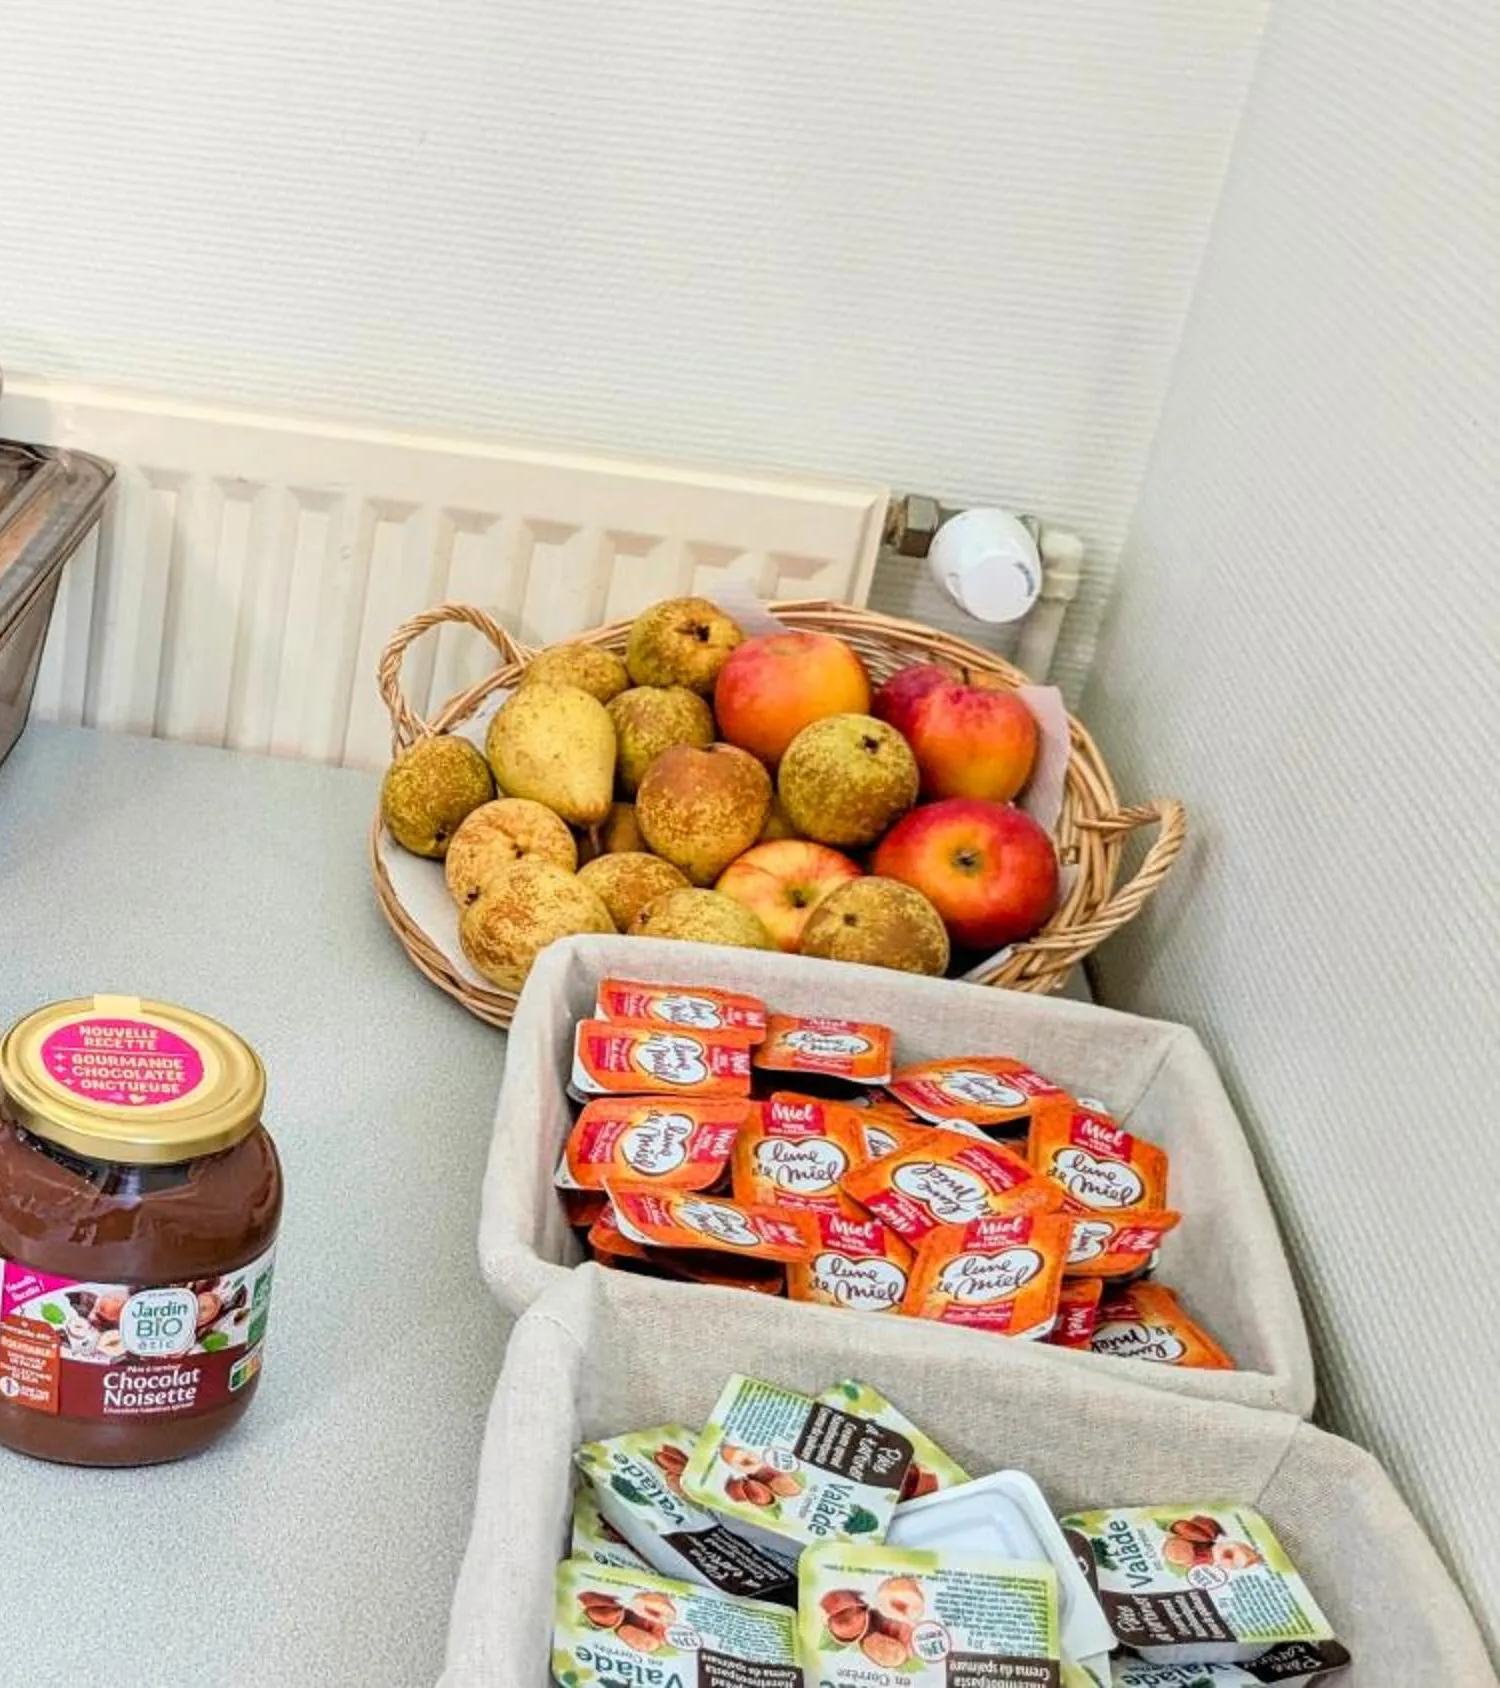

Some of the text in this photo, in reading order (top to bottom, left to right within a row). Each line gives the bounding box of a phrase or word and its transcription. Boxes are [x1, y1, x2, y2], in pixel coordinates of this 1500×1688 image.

[79, 1025, 160, 1040] NOUVELLE
[83, 1037, 156, 1051] RECETTE
[72, 1053, 186, 1071] GOURMANDE
[81, 1078, 181, 1095] ONCTUEUSE
[771, 1103, 814, 1122] Miel
[1080, 1119, 1123, 1147] Miel
[830, 1215, 874, 1238] Miel
[976, 1217, 1022, 1236] Miel
[132, 1300, 188, 1319] Jardin
[103, 1368, 201, 1390] Chocolat
[103, 1387, 197, 1408] Noisette
[613, 1453, 686, 1525] Valade
[808, 1483, 854, 1537] Valade
[1110, 1519, 1153, 1589] Valade
[575, 1646, 684, 1688] Valade
